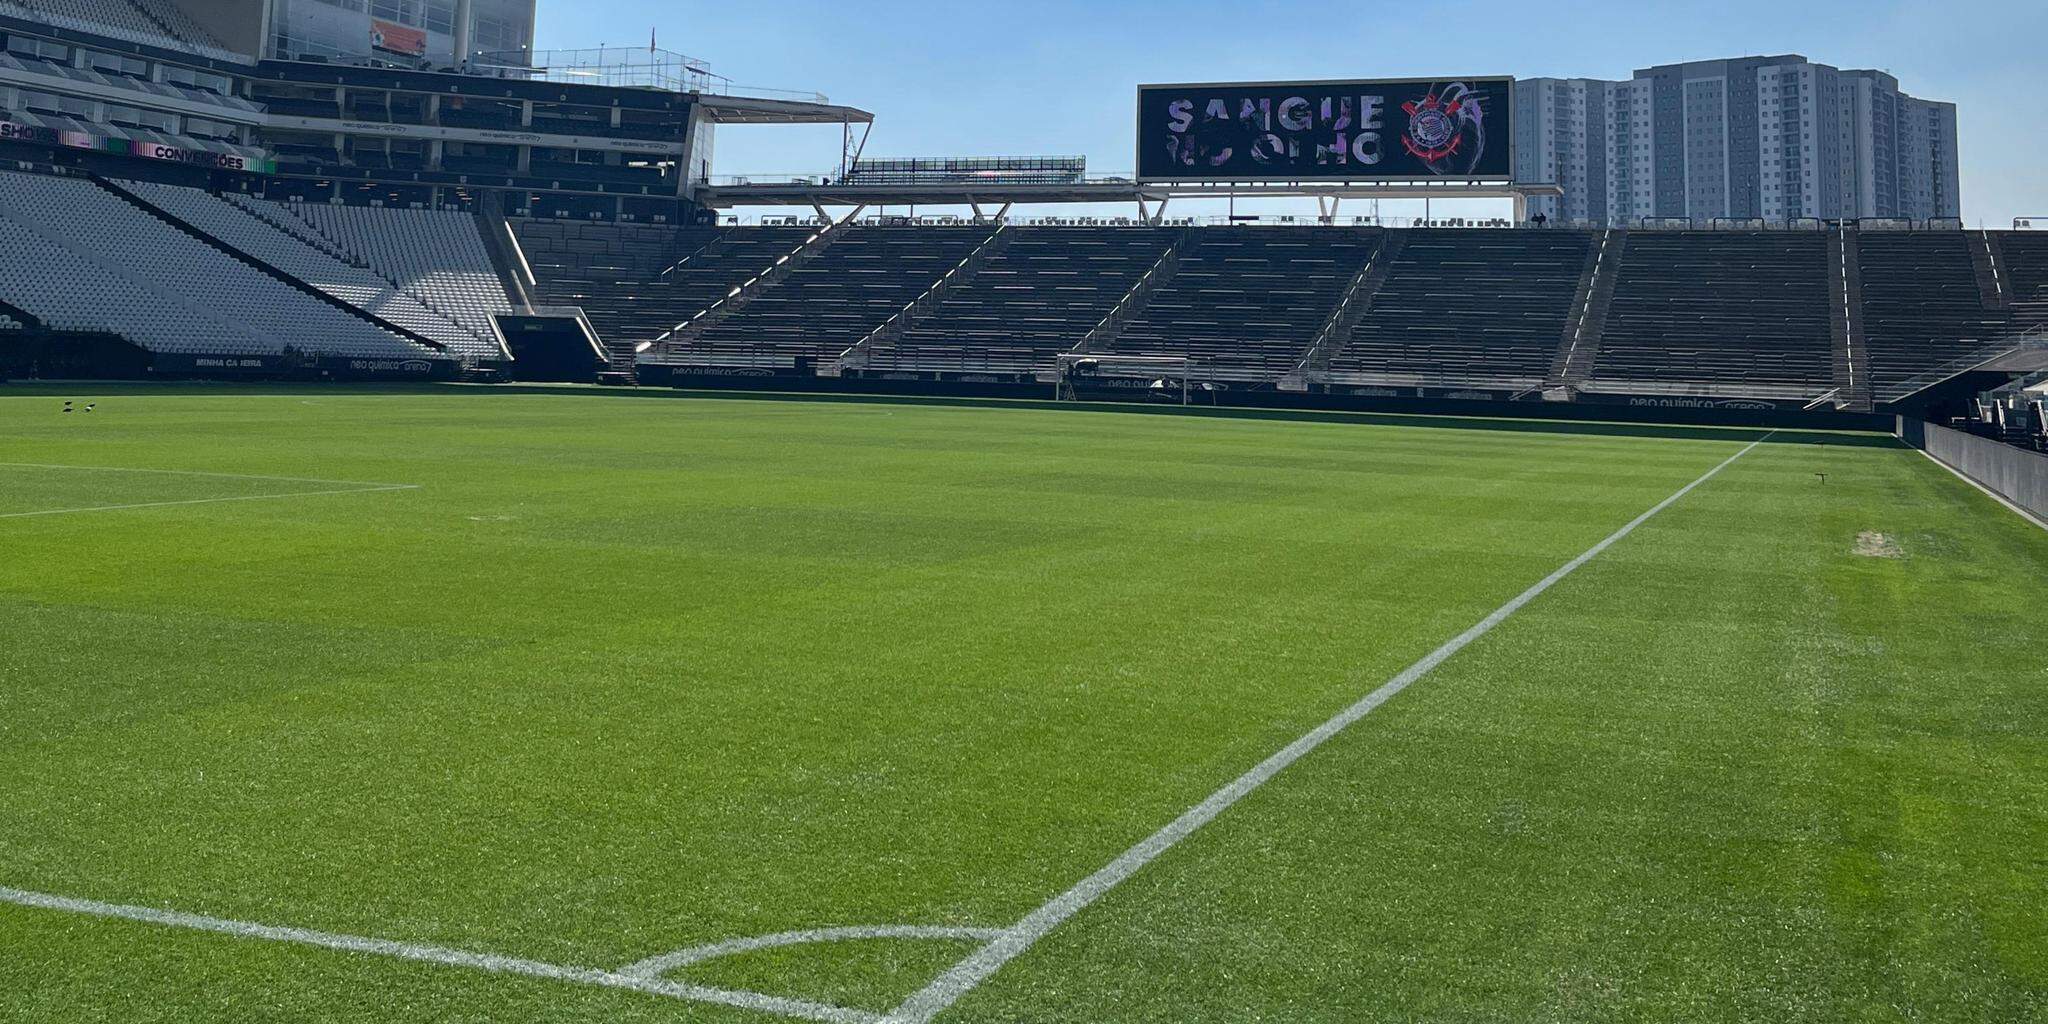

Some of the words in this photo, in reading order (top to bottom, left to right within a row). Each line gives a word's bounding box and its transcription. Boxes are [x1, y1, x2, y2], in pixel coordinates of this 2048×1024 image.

[1168, 96, 1384, 132] SANGUE
[155, 146, 243, 169] CONVEÕES
[196, 358, 224, 367] MINHA
[226, 358, 262, 367] CAEIRA
[350, 360, 367, 369] neo
[368, 359, 399, 372] química
[1630, 397, 1657, 407] neo
